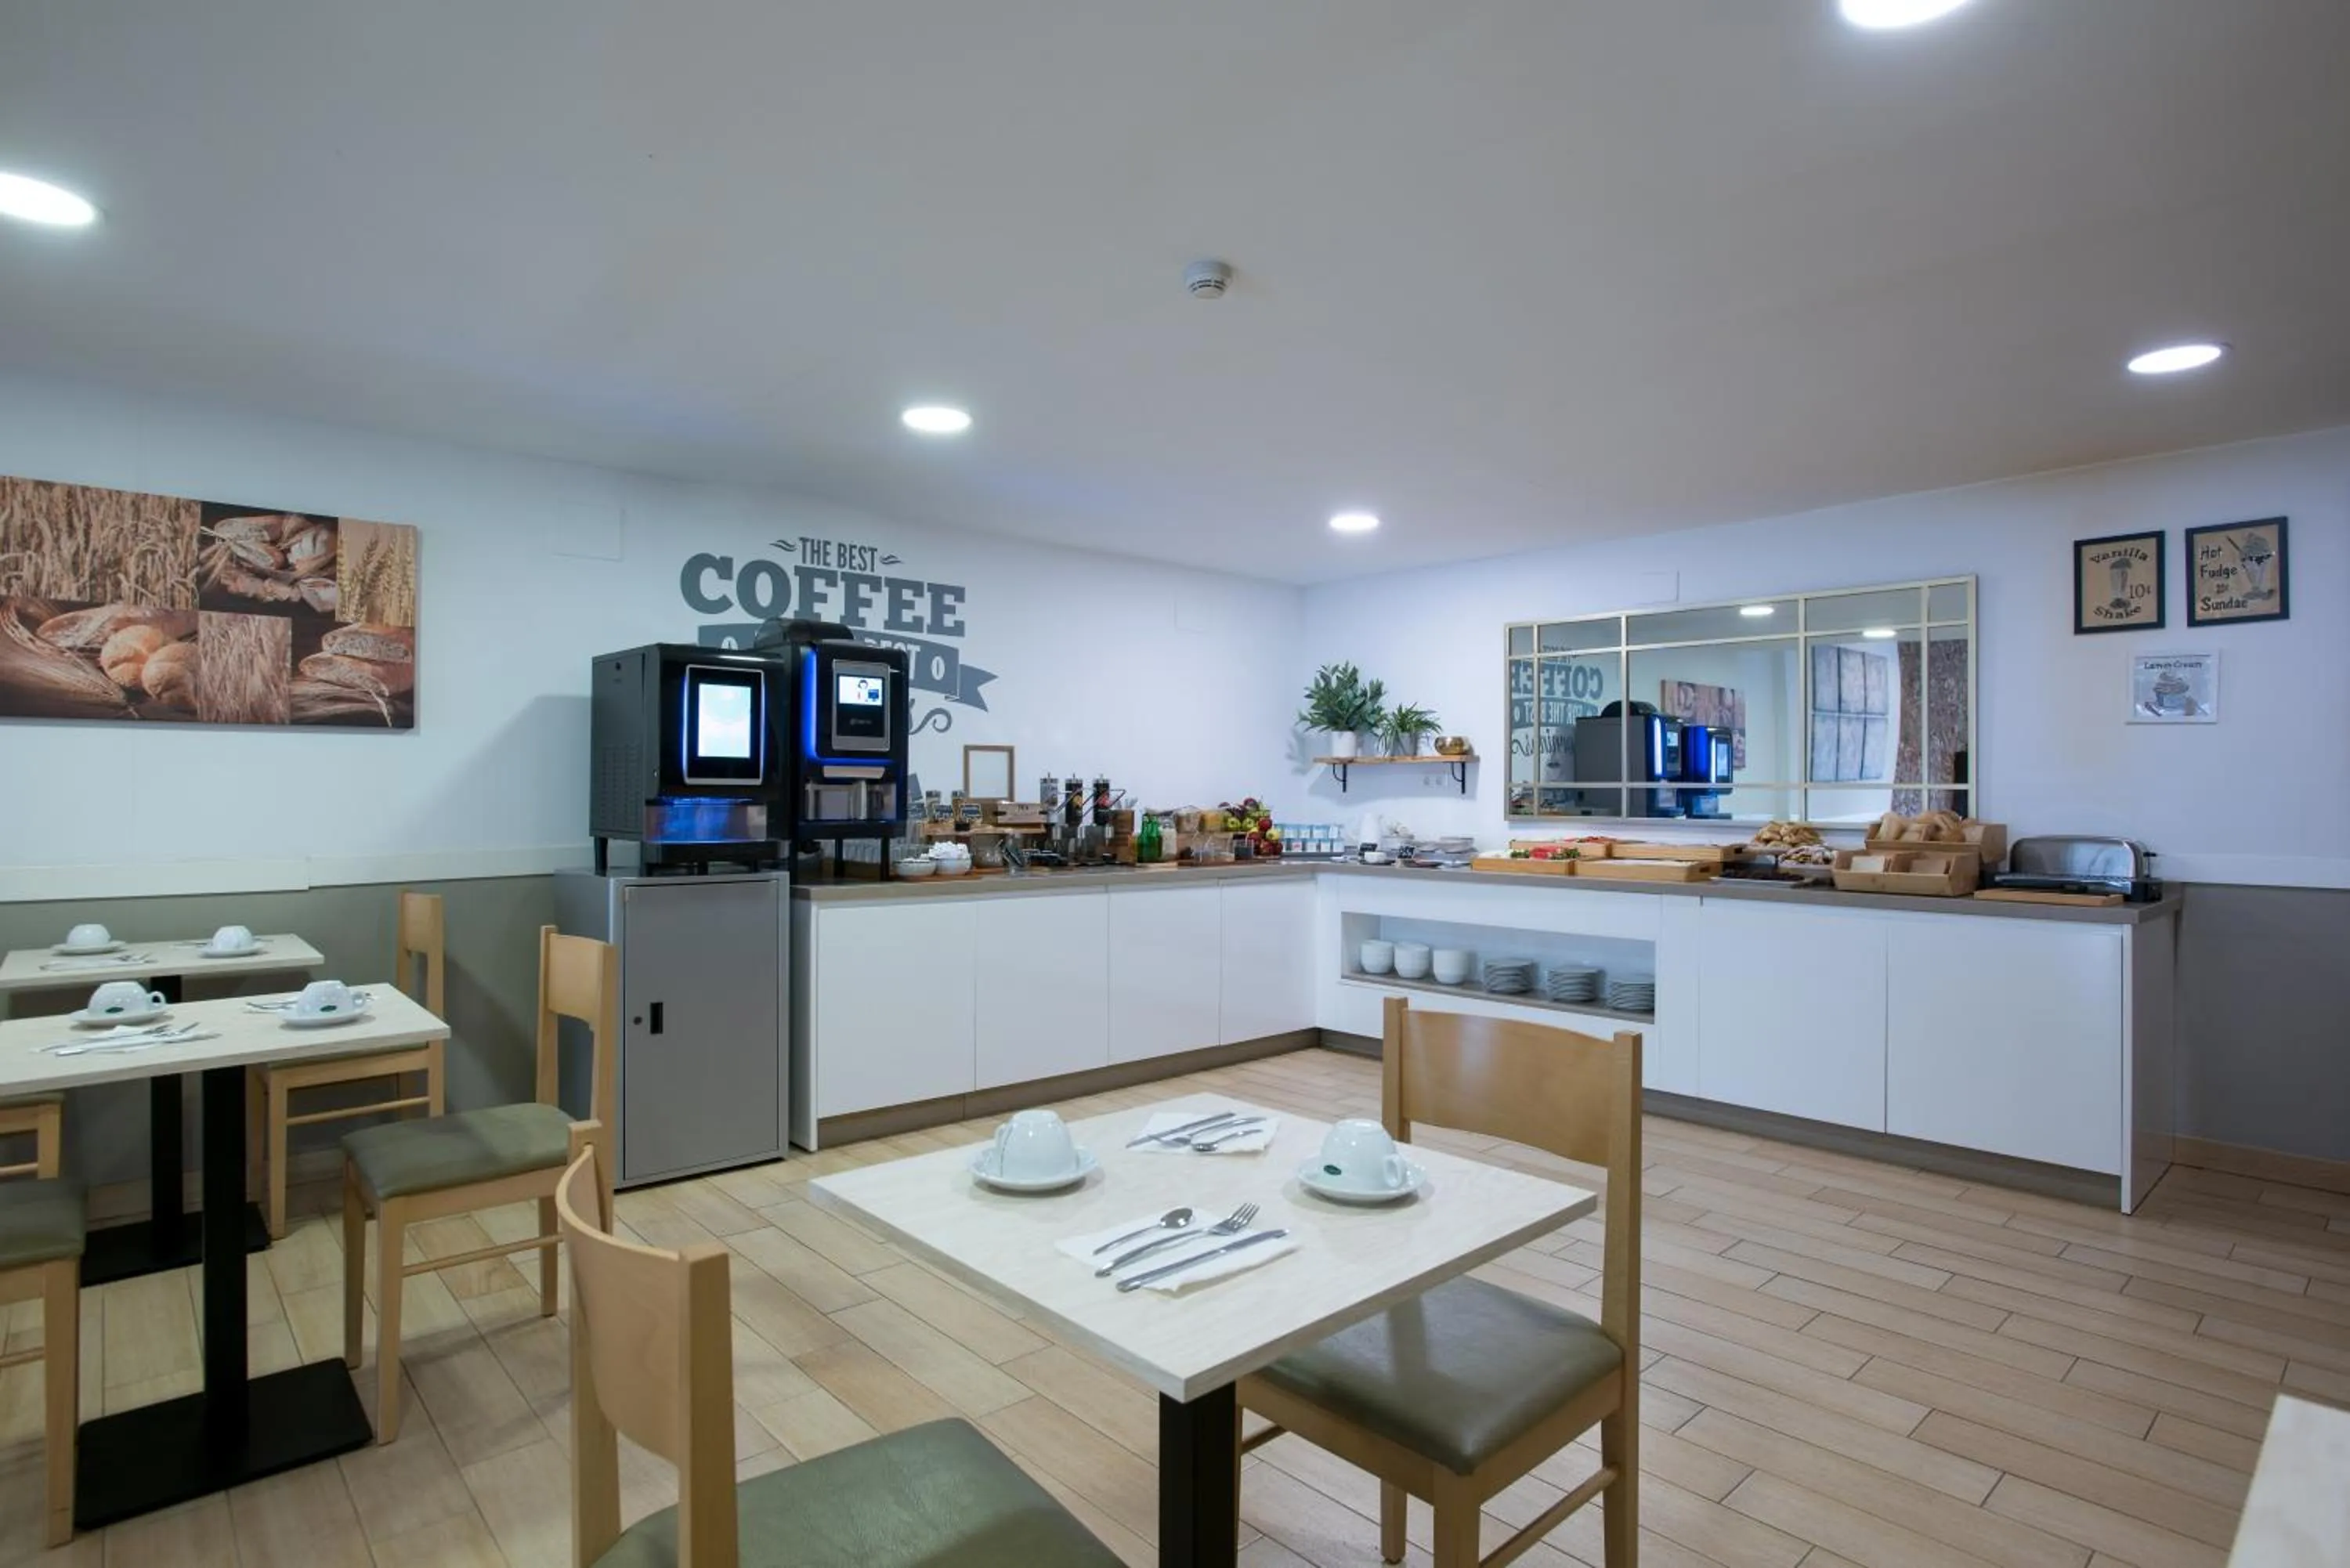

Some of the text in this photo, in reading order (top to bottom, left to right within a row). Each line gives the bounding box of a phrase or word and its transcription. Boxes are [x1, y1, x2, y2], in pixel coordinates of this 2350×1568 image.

[798, 537, 878, 573] THE BEST
[2088, 547, 2148, 564] Vanilla
[2200, 545, 2222, 560] Hot
[2200, 563, 2238, 579] Fudge
[680, 552, 965, 638] COFFEE
[2093, 605, 2142, 619] Shake
[2200, 596, 2249, 612] Sundae
